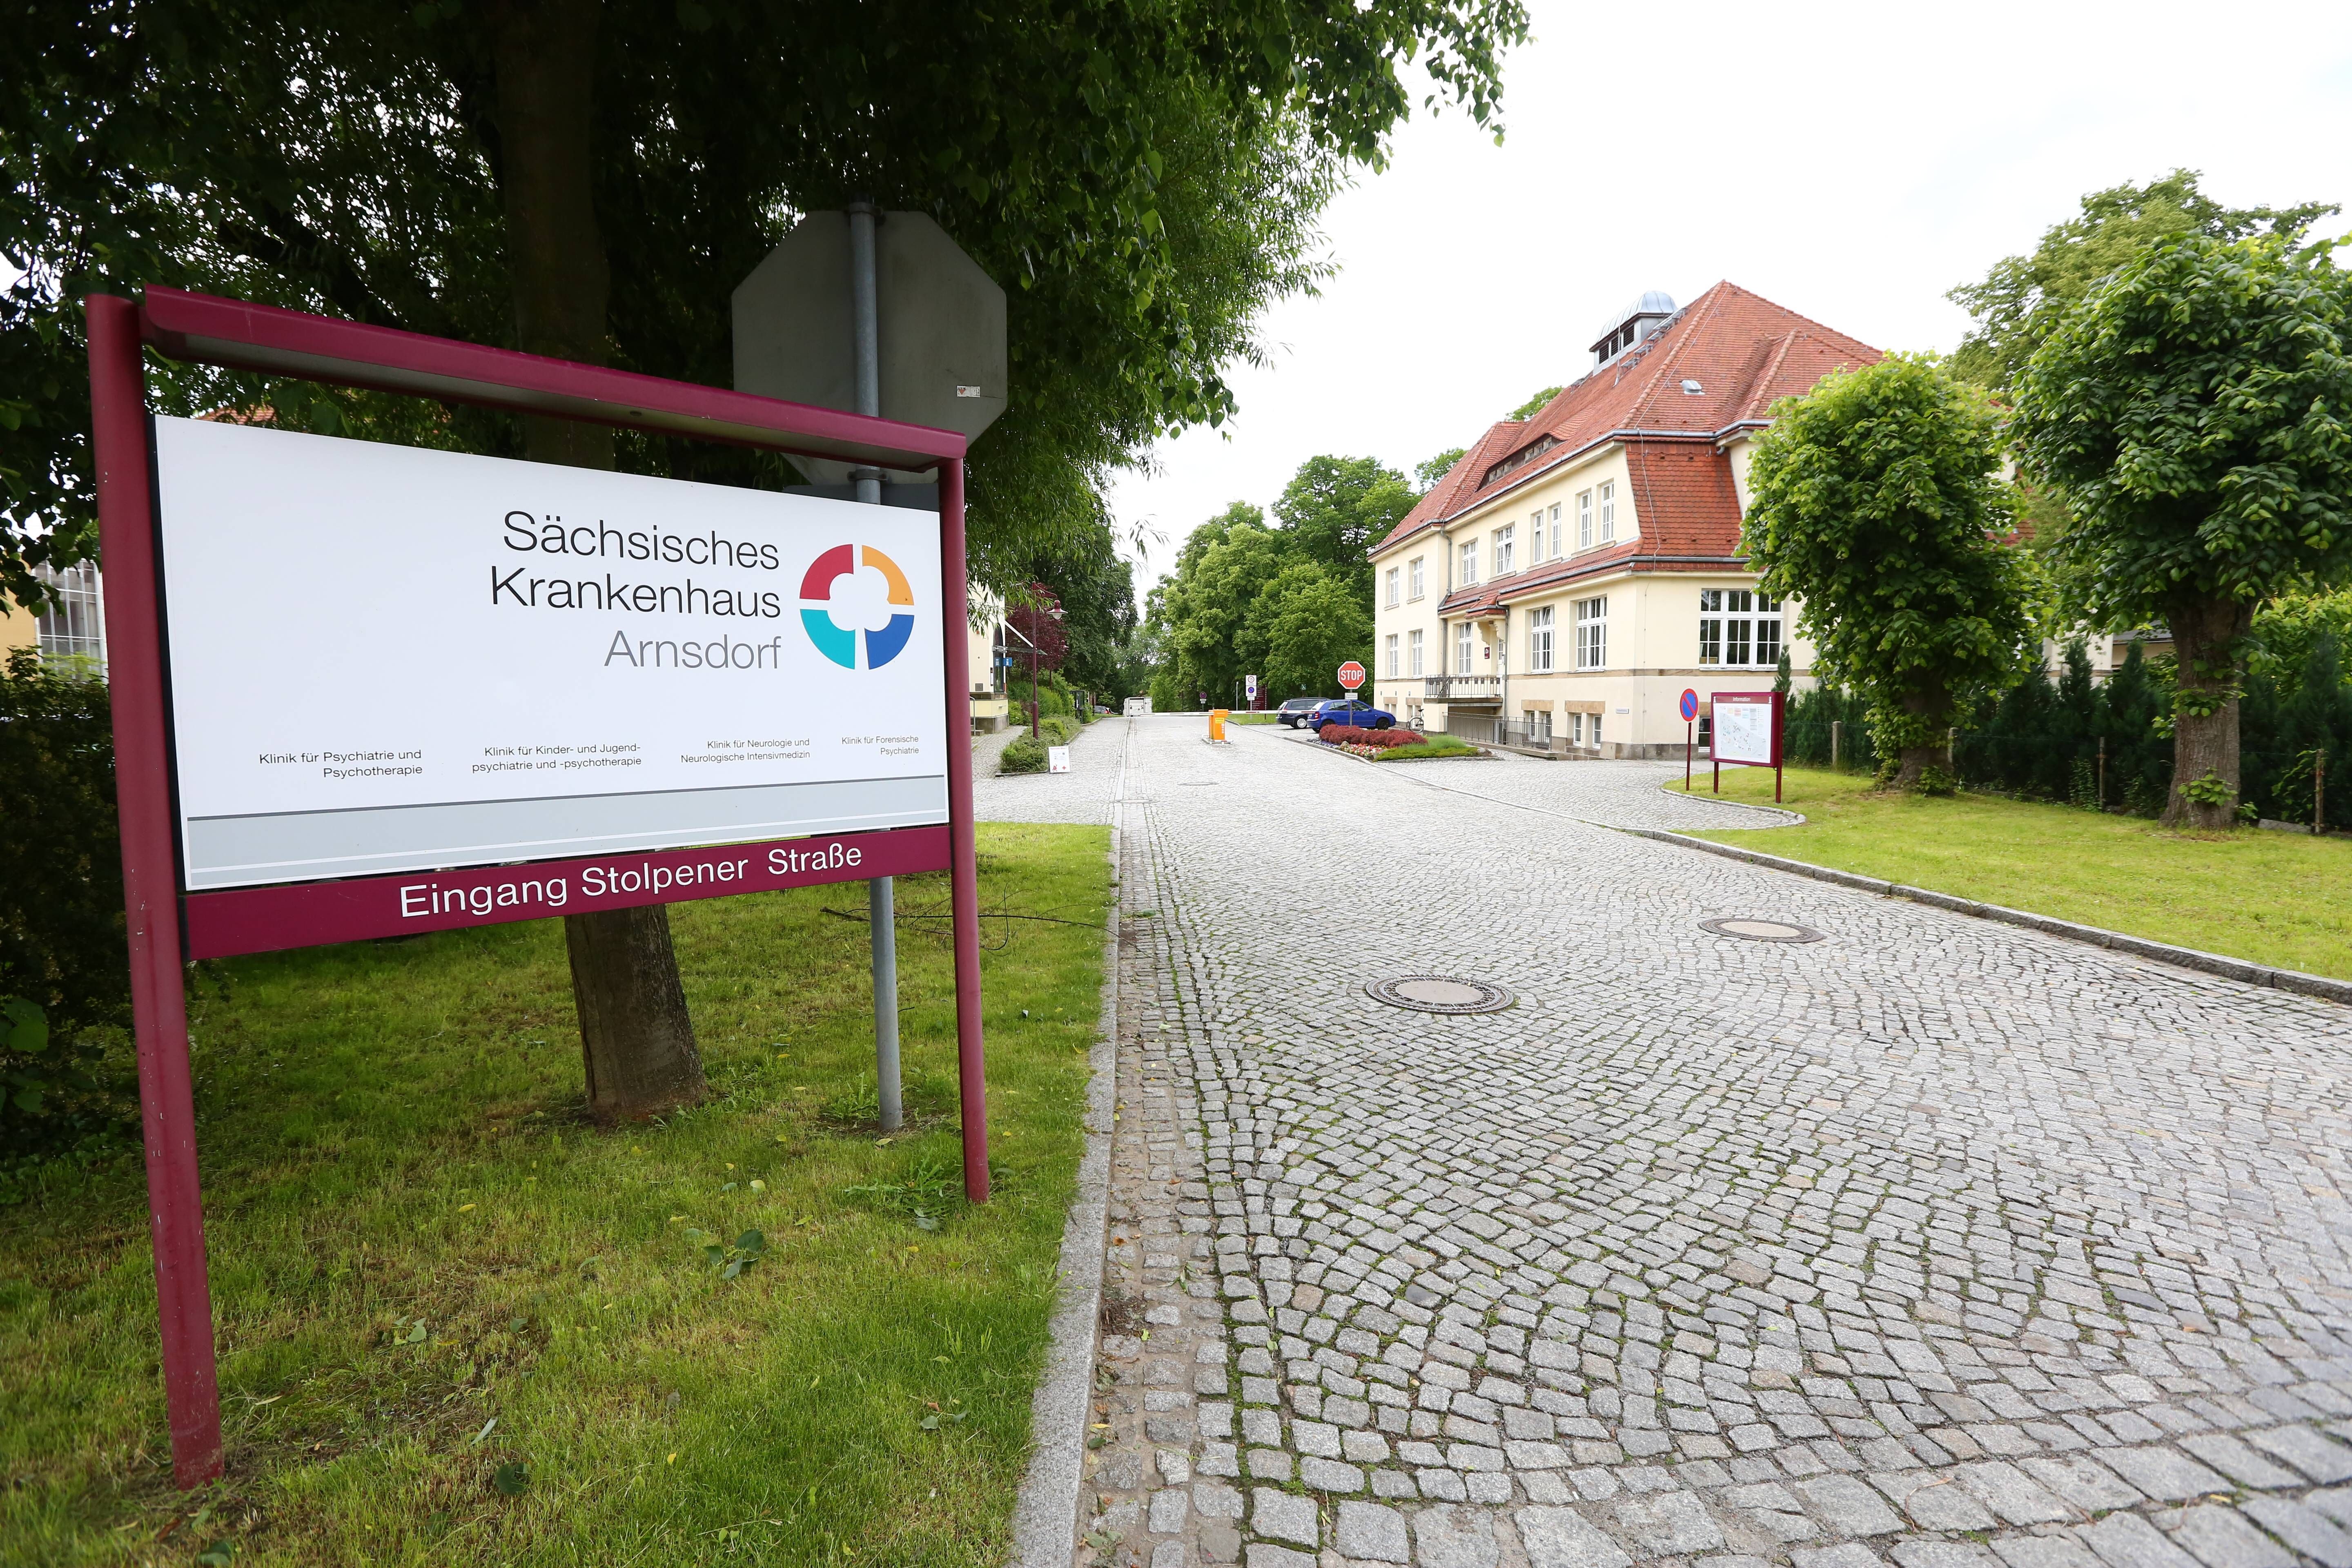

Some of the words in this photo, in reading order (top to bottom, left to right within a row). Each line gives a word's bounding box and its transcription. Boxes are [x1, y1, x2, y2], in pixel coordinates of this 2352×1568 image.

[503, 510, 779, 570] Sächsisches
[491, 566, 781, 618] Krankenhaus
[604, 630, 782, 669] Arnsdorf
[1341, 670, 1363, 681] STOP
[707, 740, 731, 749] Klinik
[733, 740, 745, 748] für
[747, 739, 792, 748] Neurologie
[794, 738, 810, 746] und
[876, 735, 919, 744] Forensische
[259, 753, 297, 764] Klinik
[301, 753, 319, 763] für
[323, 750, 394, 764] Psychiatrie
[398, 749, 421, 760] und
[485, 746, 515, 756] Klinik
[517, 746, 533, 755] für
[536, 745, 574, 755] Kinder-
[577, 744, 597, 753] und
[599, 743, 641, 754] Jugend-
[880, 747, 919, 757] Psychiatrie
[681, 753, 745, 764] Neurologische
[747, 751, 810, 760] Intensivmedizin
[323, 764, 423, 780] Psychotherapie
[472, 760, 533, 774] psychiatrie
[536, 760, 556, 769] und
[559, 757, 641, 770] -psychotherapie
[400, 878, 567, 918] Eingang
[581, 859, 748, 896] Stolpener
[768, 843, 862, 875] Straße
